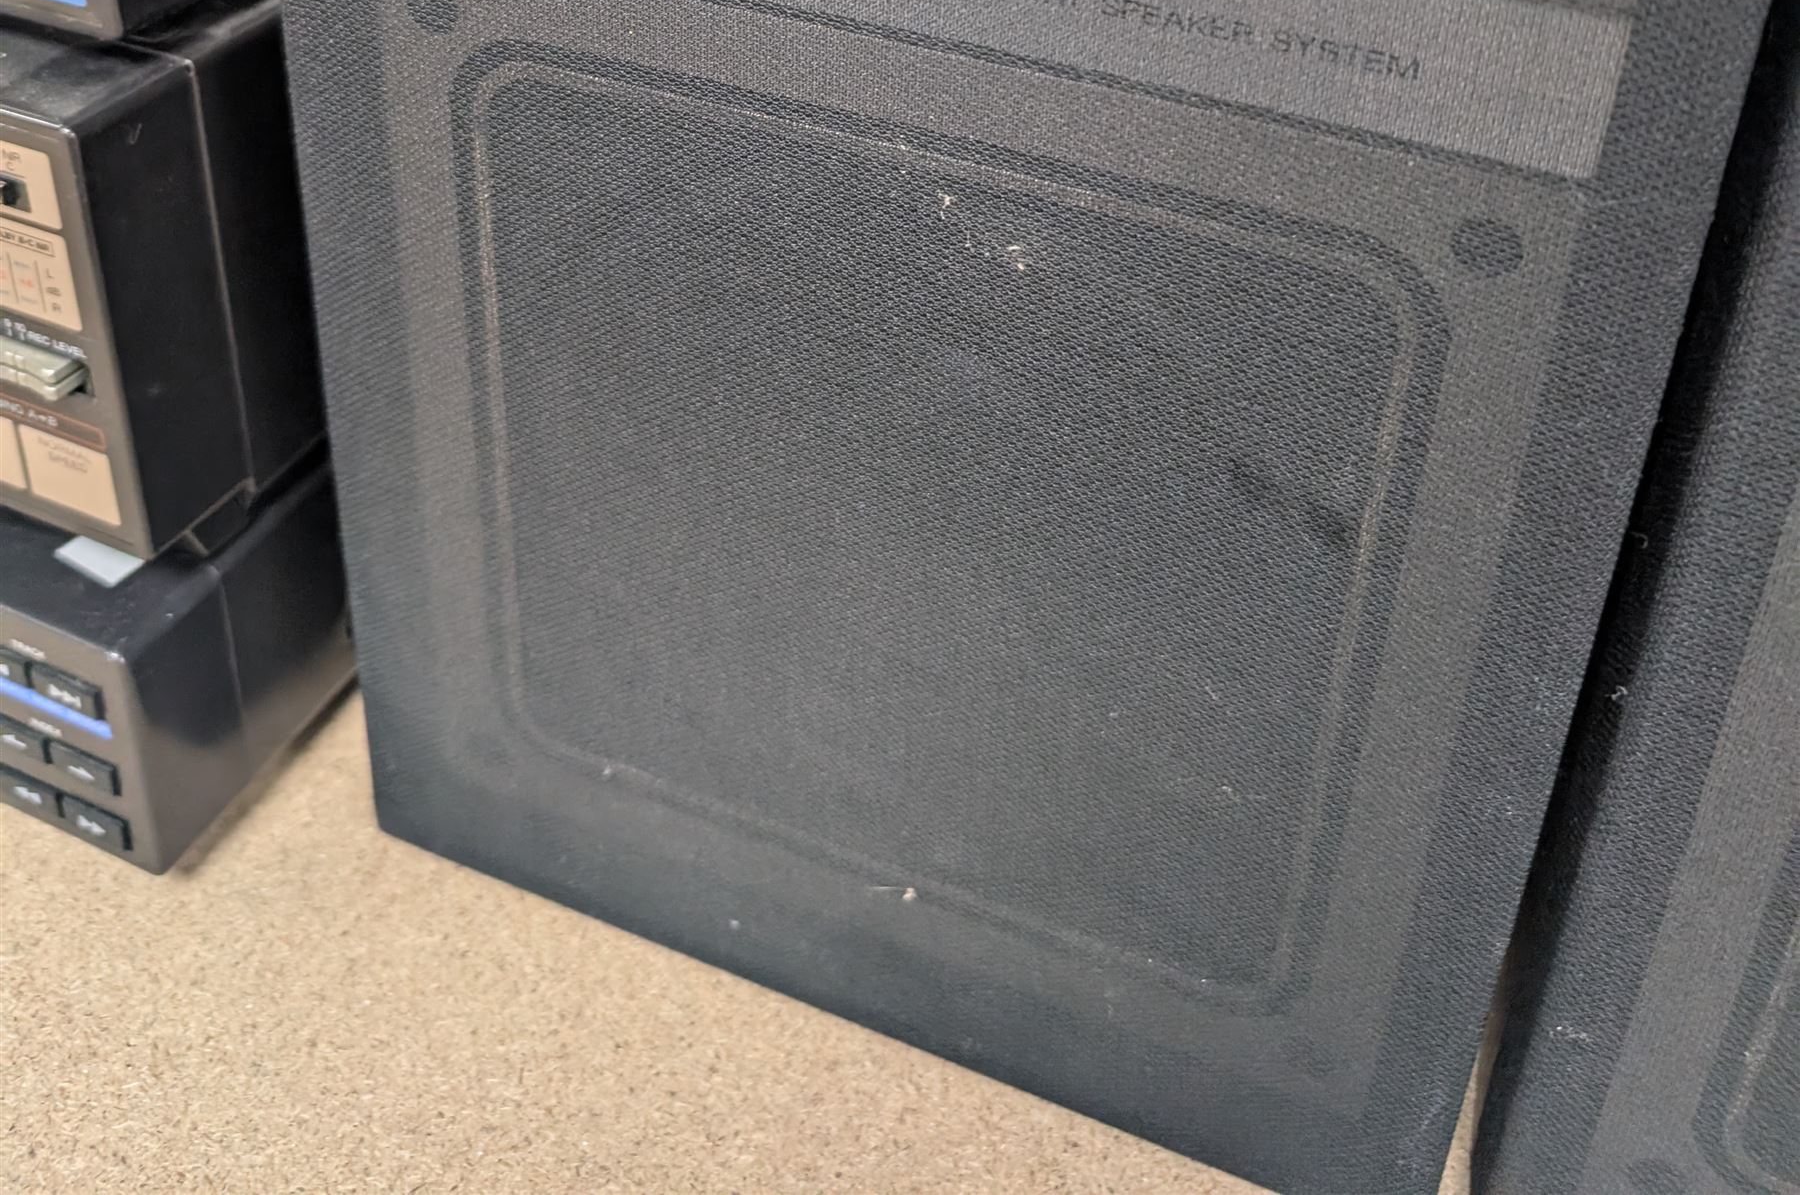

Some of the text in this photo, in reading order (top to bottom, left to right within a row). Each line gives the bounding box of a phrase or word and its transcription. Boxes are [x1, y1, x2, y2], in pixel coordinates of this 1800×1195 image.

[1271, 30, 1421, 81] SYSTEM
[27, 330, 88, 361] REC LEVEL
